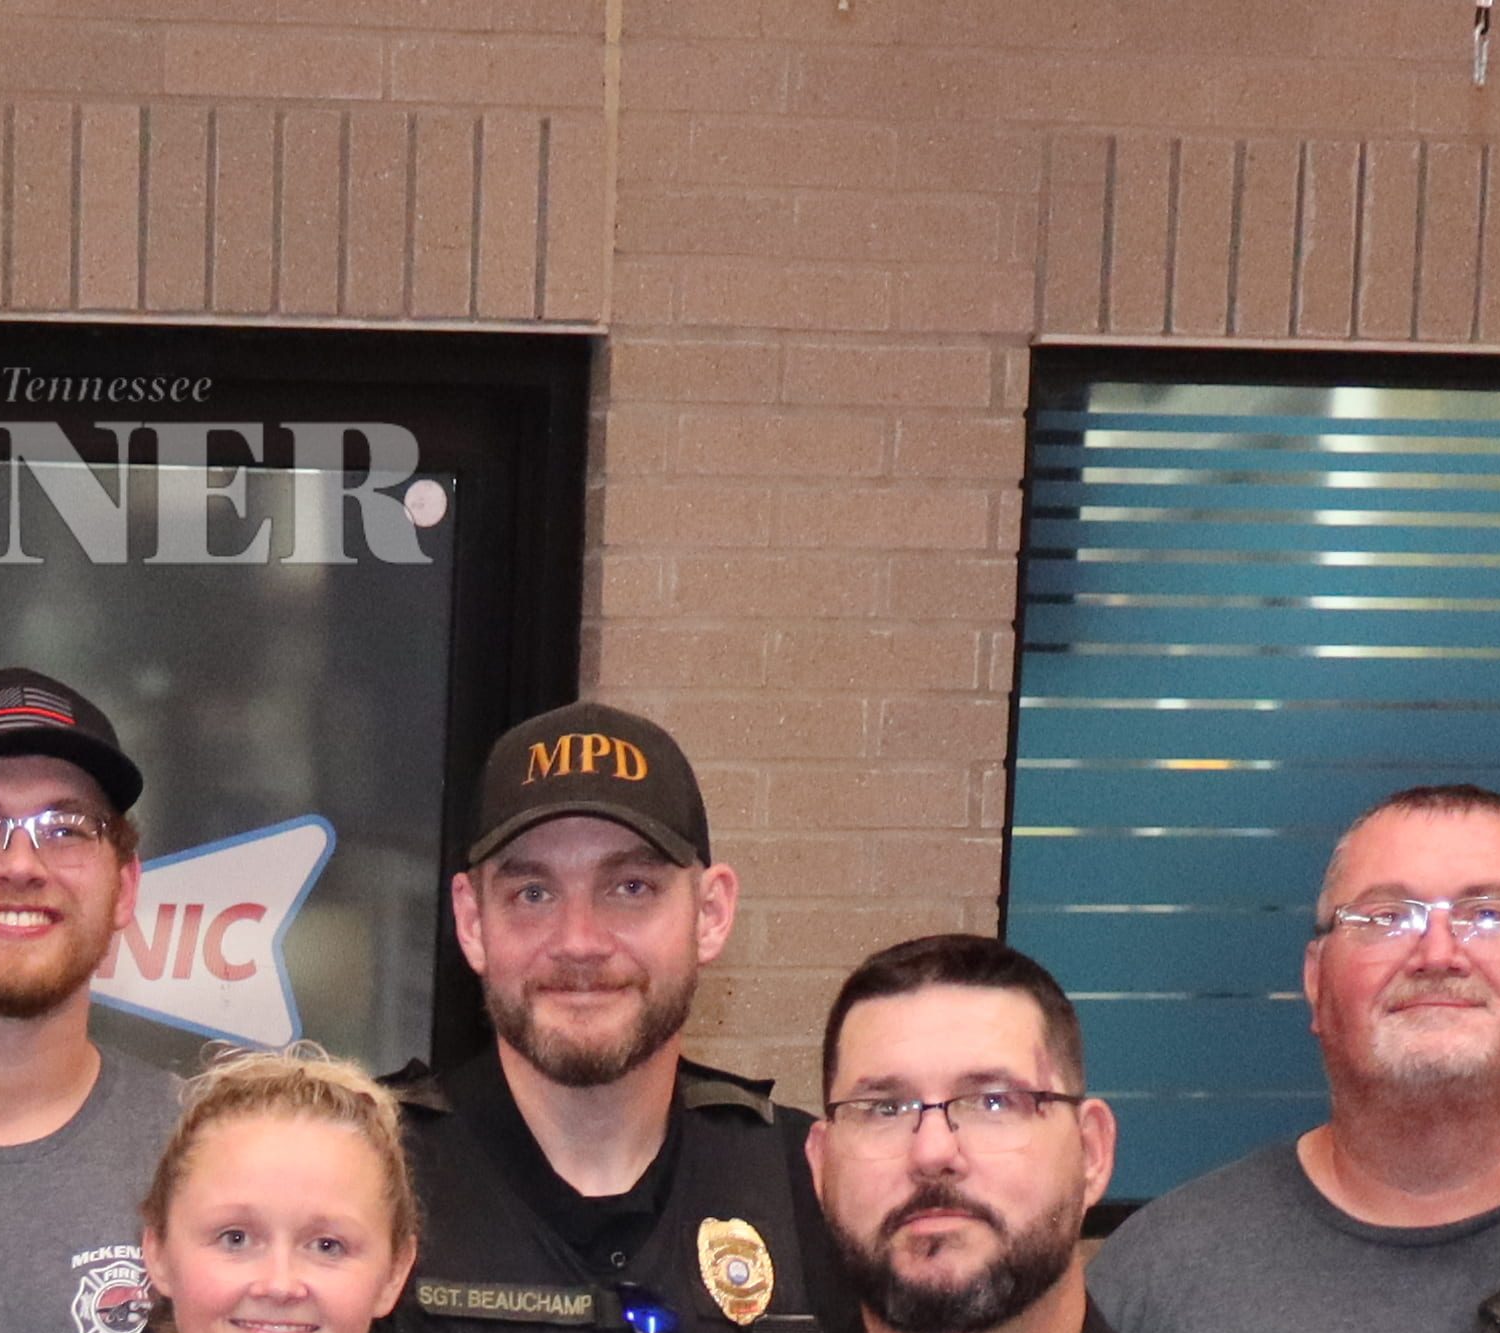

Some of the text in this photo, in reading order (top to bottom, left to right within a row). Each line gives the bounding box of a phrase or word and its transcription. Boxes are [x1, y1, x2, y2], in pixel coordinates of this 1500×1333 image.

[521, 733, 648, 786] MPD
[103, 1267, 140, 1282] FIRE
[419, 1285, 593, 1316] SGT. BEAUCHAMP
